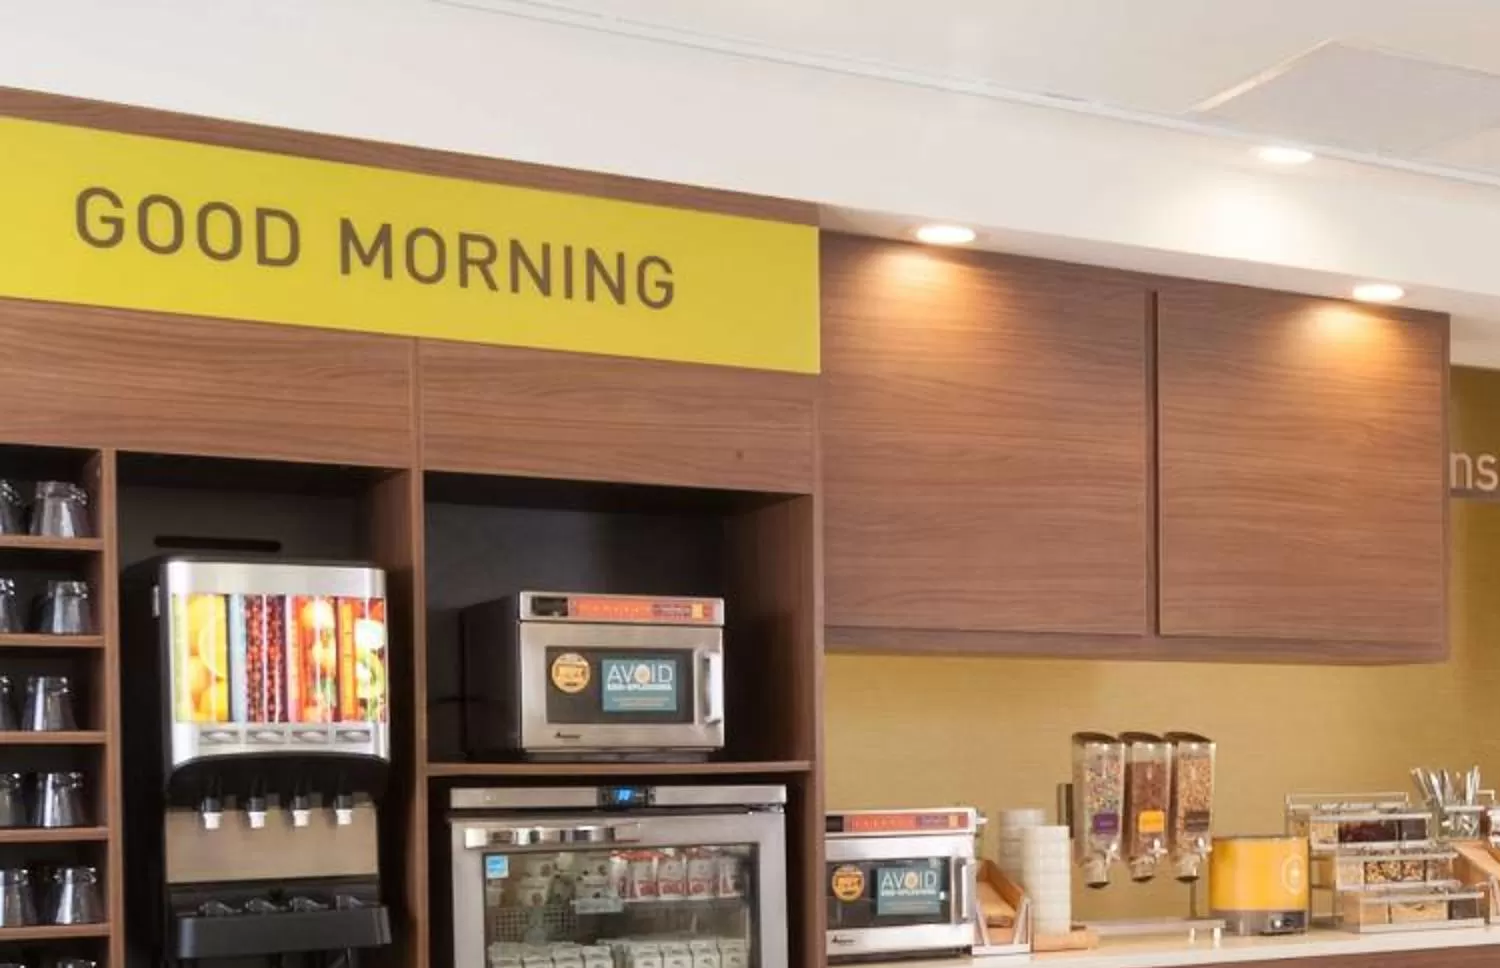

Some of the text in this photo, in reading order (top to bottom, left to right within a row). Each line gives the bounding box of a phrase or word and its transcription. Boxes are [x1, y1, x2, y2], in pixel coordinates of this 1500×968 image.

[76, 187, 676, 310] GOOD MORNING
[607, 664, 672, 684] AVOID
[881, 871, 937, 890] AVOID
